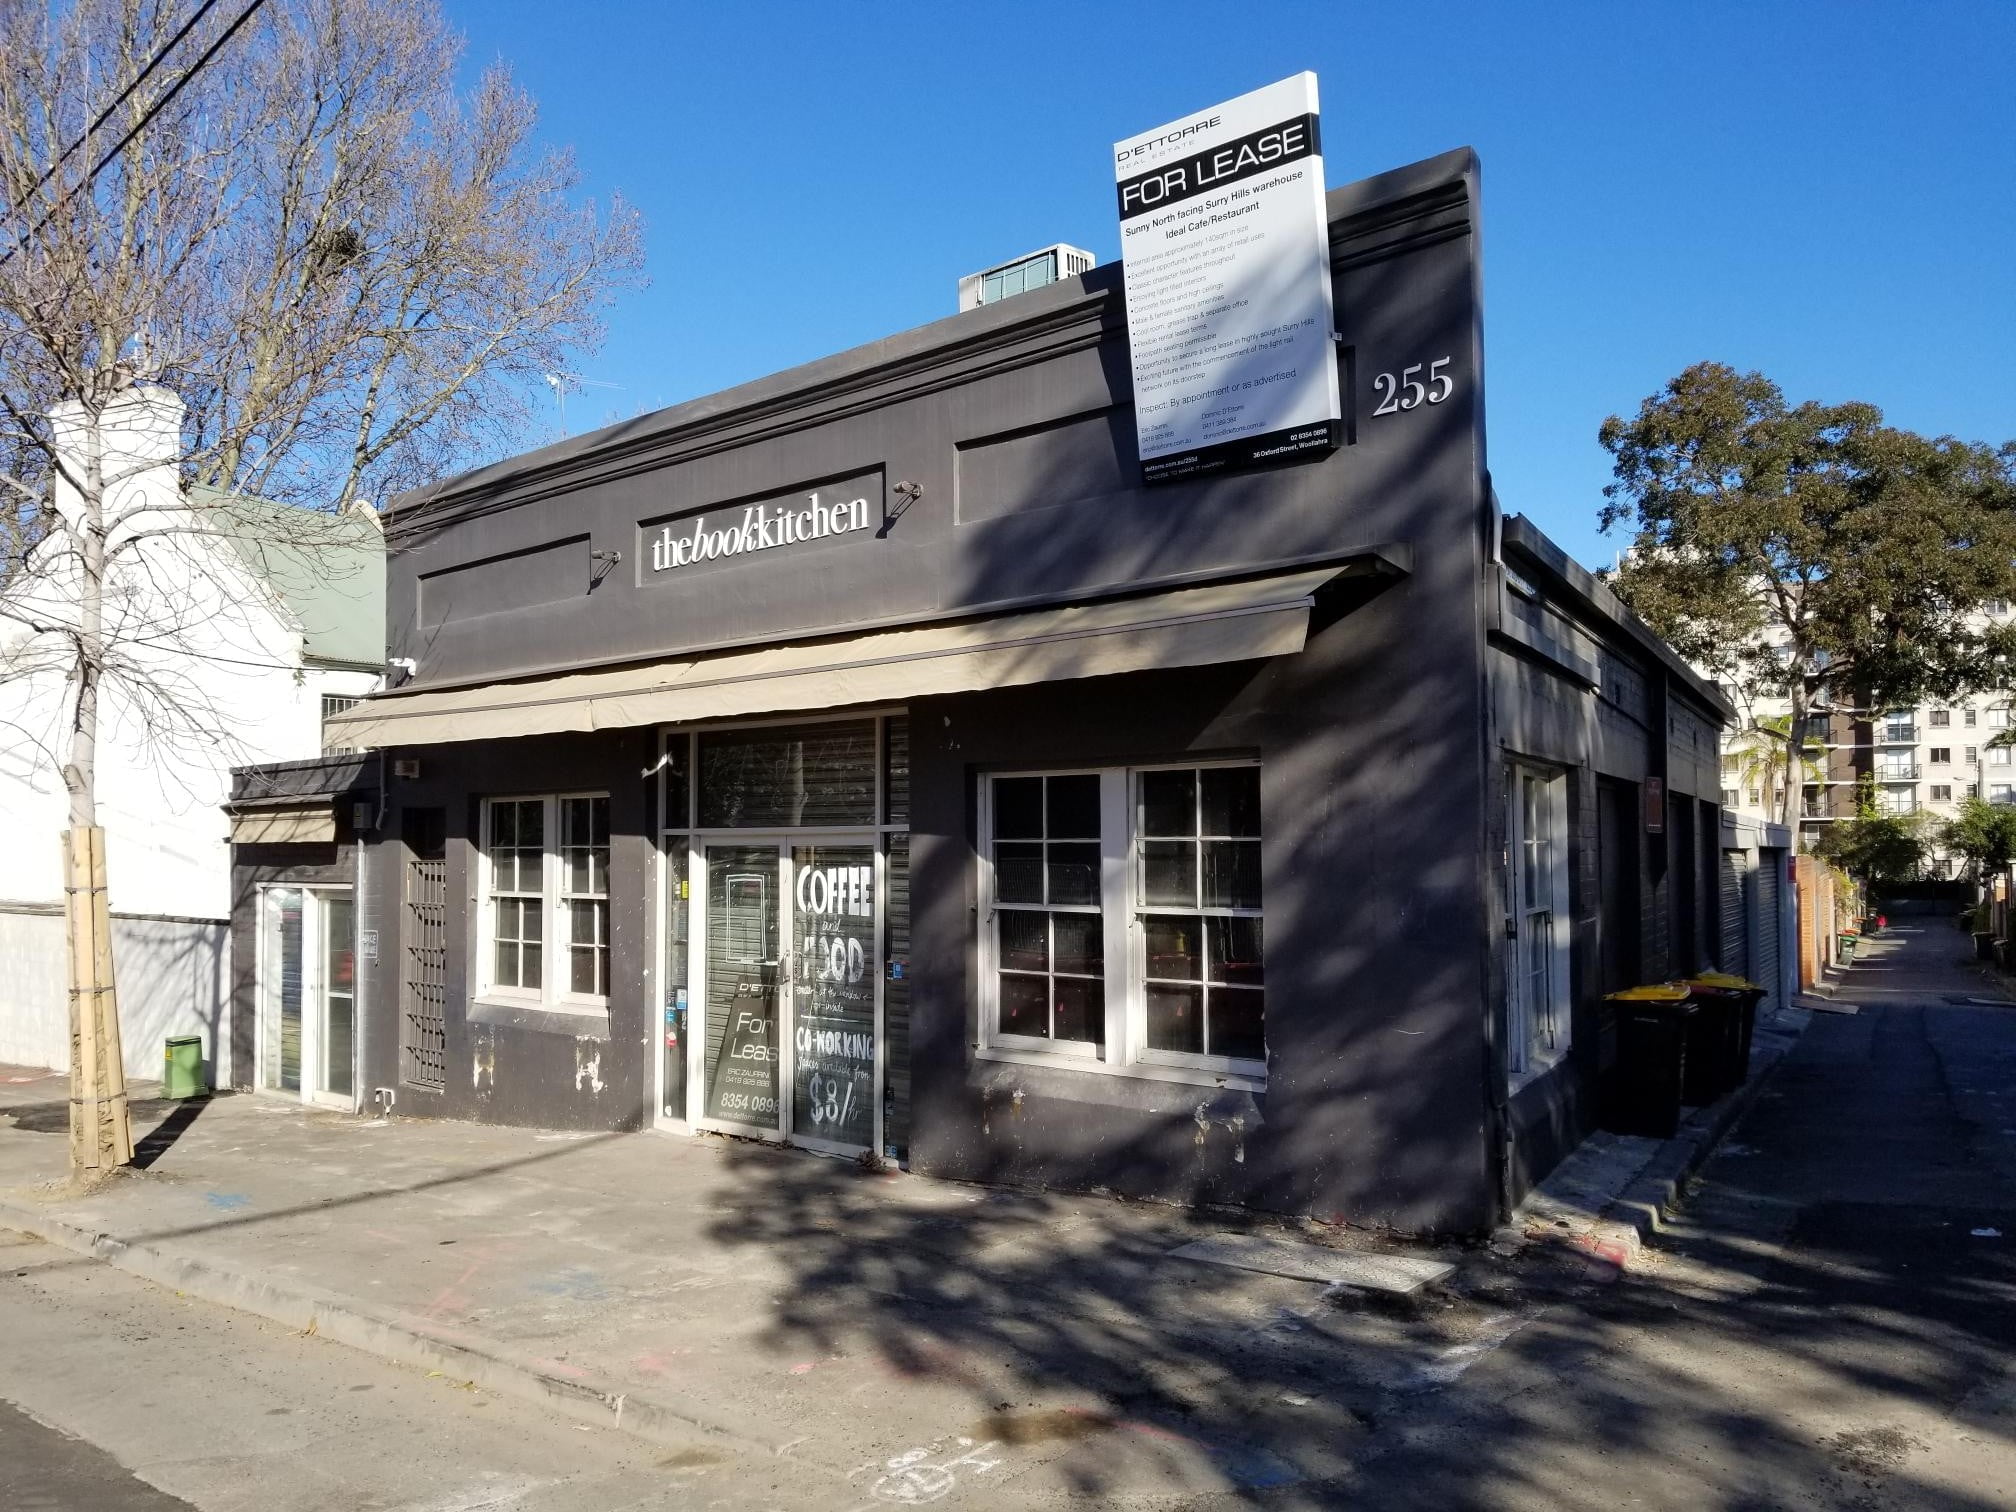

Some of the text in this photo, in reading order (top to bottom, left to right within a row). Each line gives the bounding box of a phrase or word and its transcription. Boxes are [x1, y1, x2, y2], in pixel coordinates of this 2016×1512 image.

[1117, 115, 1221, 162] D'ETTORRE
[1118, 140, 1194, 172] REAL ESTATE
[1123, 124, 1304, 210] FOR LEASE
[1125, 170, 1302, 238] Sunny North facing Surry Hills warehouse
[1166, 201, 1259, 239] Ideal Cafe/Restaurant
[1156, 257, 1187, 271] opportunity
[1189, 252, 1200, 261] with
[1214, 245, 1225, 254] array
[1250, 233, 1264, 241] uses
[1164, 240, 1203, 257] approximately
[1237, 225, 1248, 233] size
[1203, 254, 1235, 269] throughout
[1188, 289, 1200, 298] high
[1205, 304, 1230, 317] separate
[1232, 299, 1248, 308] office
[1190, 324, 1207, 332] terms
[1260, 327, 1280, 338] sought
[1283, 323, 1299, 332] Surry
[1269, 339, 1283, 348] light
[1139, 402, 1167, 414] Inspect:
[1170, 398, 1179, 407] By
[1182, 386, 1229, 404] appointment
[1242, 381, 1252, 389] as
[1254, 369, 1296, 386] advertised
[1180, 372, 1205, 383] doorstep
[1372, 356, 1453, 417] 255
[1261, 449, 1279, 457] Oxford
[652, 493, 870, 572] thebookkitchen
[797, 865, 871, 917] COFFEE
[822, 918, 843, 933] and
[803, 935, 865, 983] FOOD
[739, 983, 779, 993] D'ETTO
[735, 1012, 773, 1034] For
[730, 1037, 779, 1062] Leas
[796, 1026, 875, 1061] CO-WORKING
[720, 1092, 779, 1114] 8354 0896
